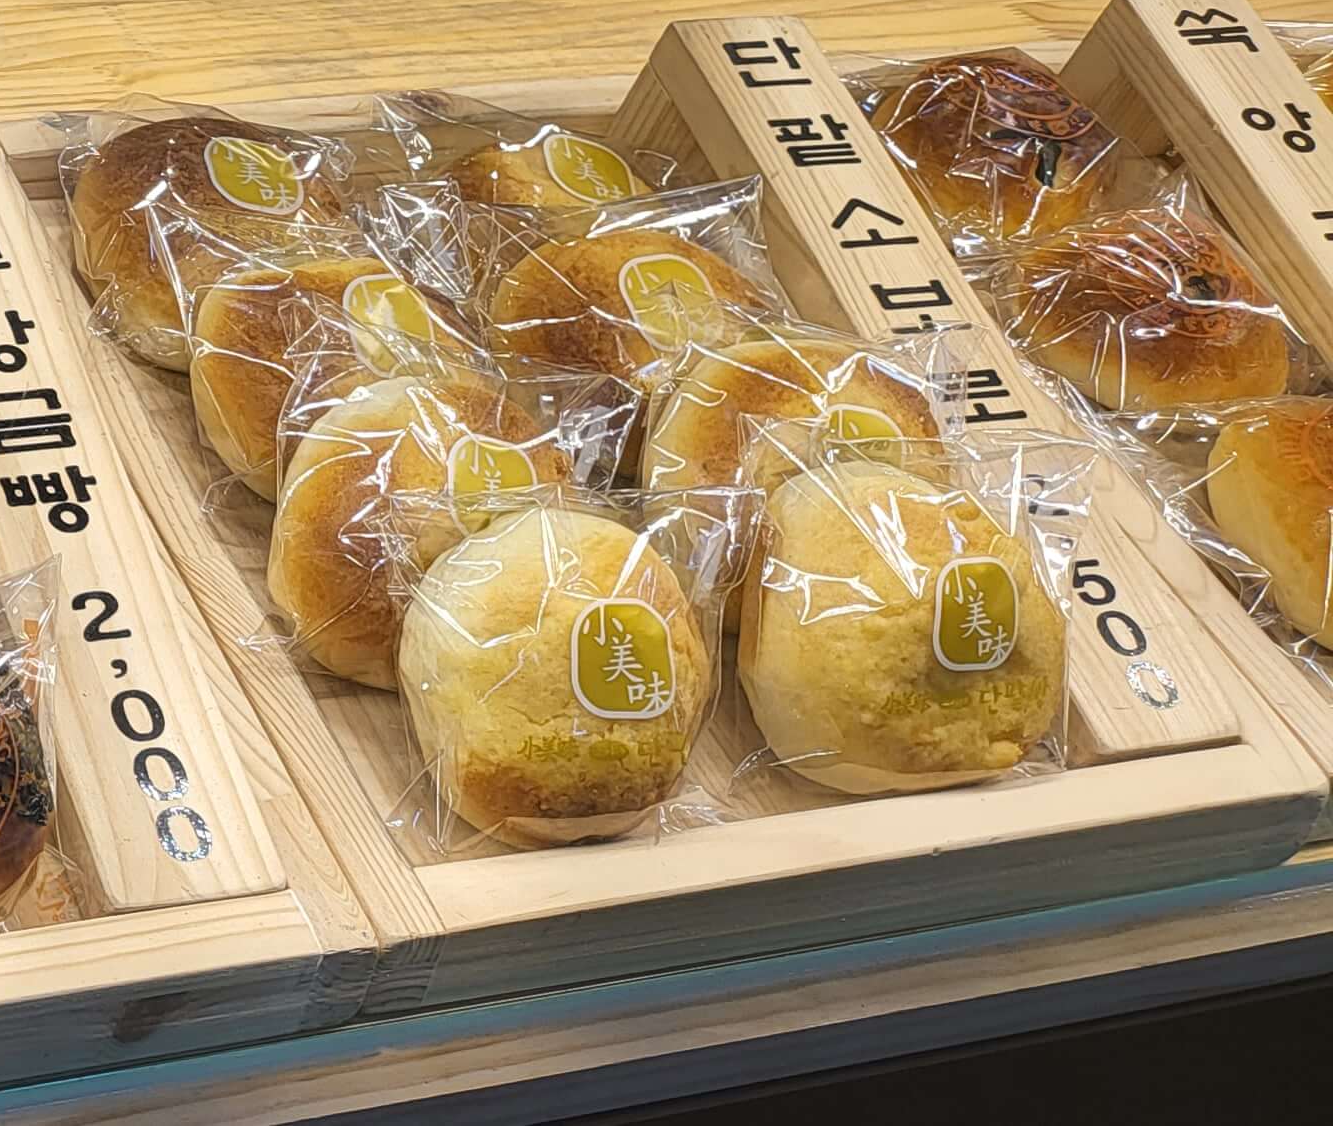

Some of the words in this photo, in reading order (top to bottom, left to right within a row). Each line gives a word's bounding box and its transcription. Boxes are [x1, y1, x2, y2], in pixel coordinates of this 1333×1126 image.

[1174, 9, 1333, 241] 쑥앙
[583, 604, 671, 711] 小美味
[943, 565, 1013, 664] 小美味
[71, 591, 213, 863] 2,000
